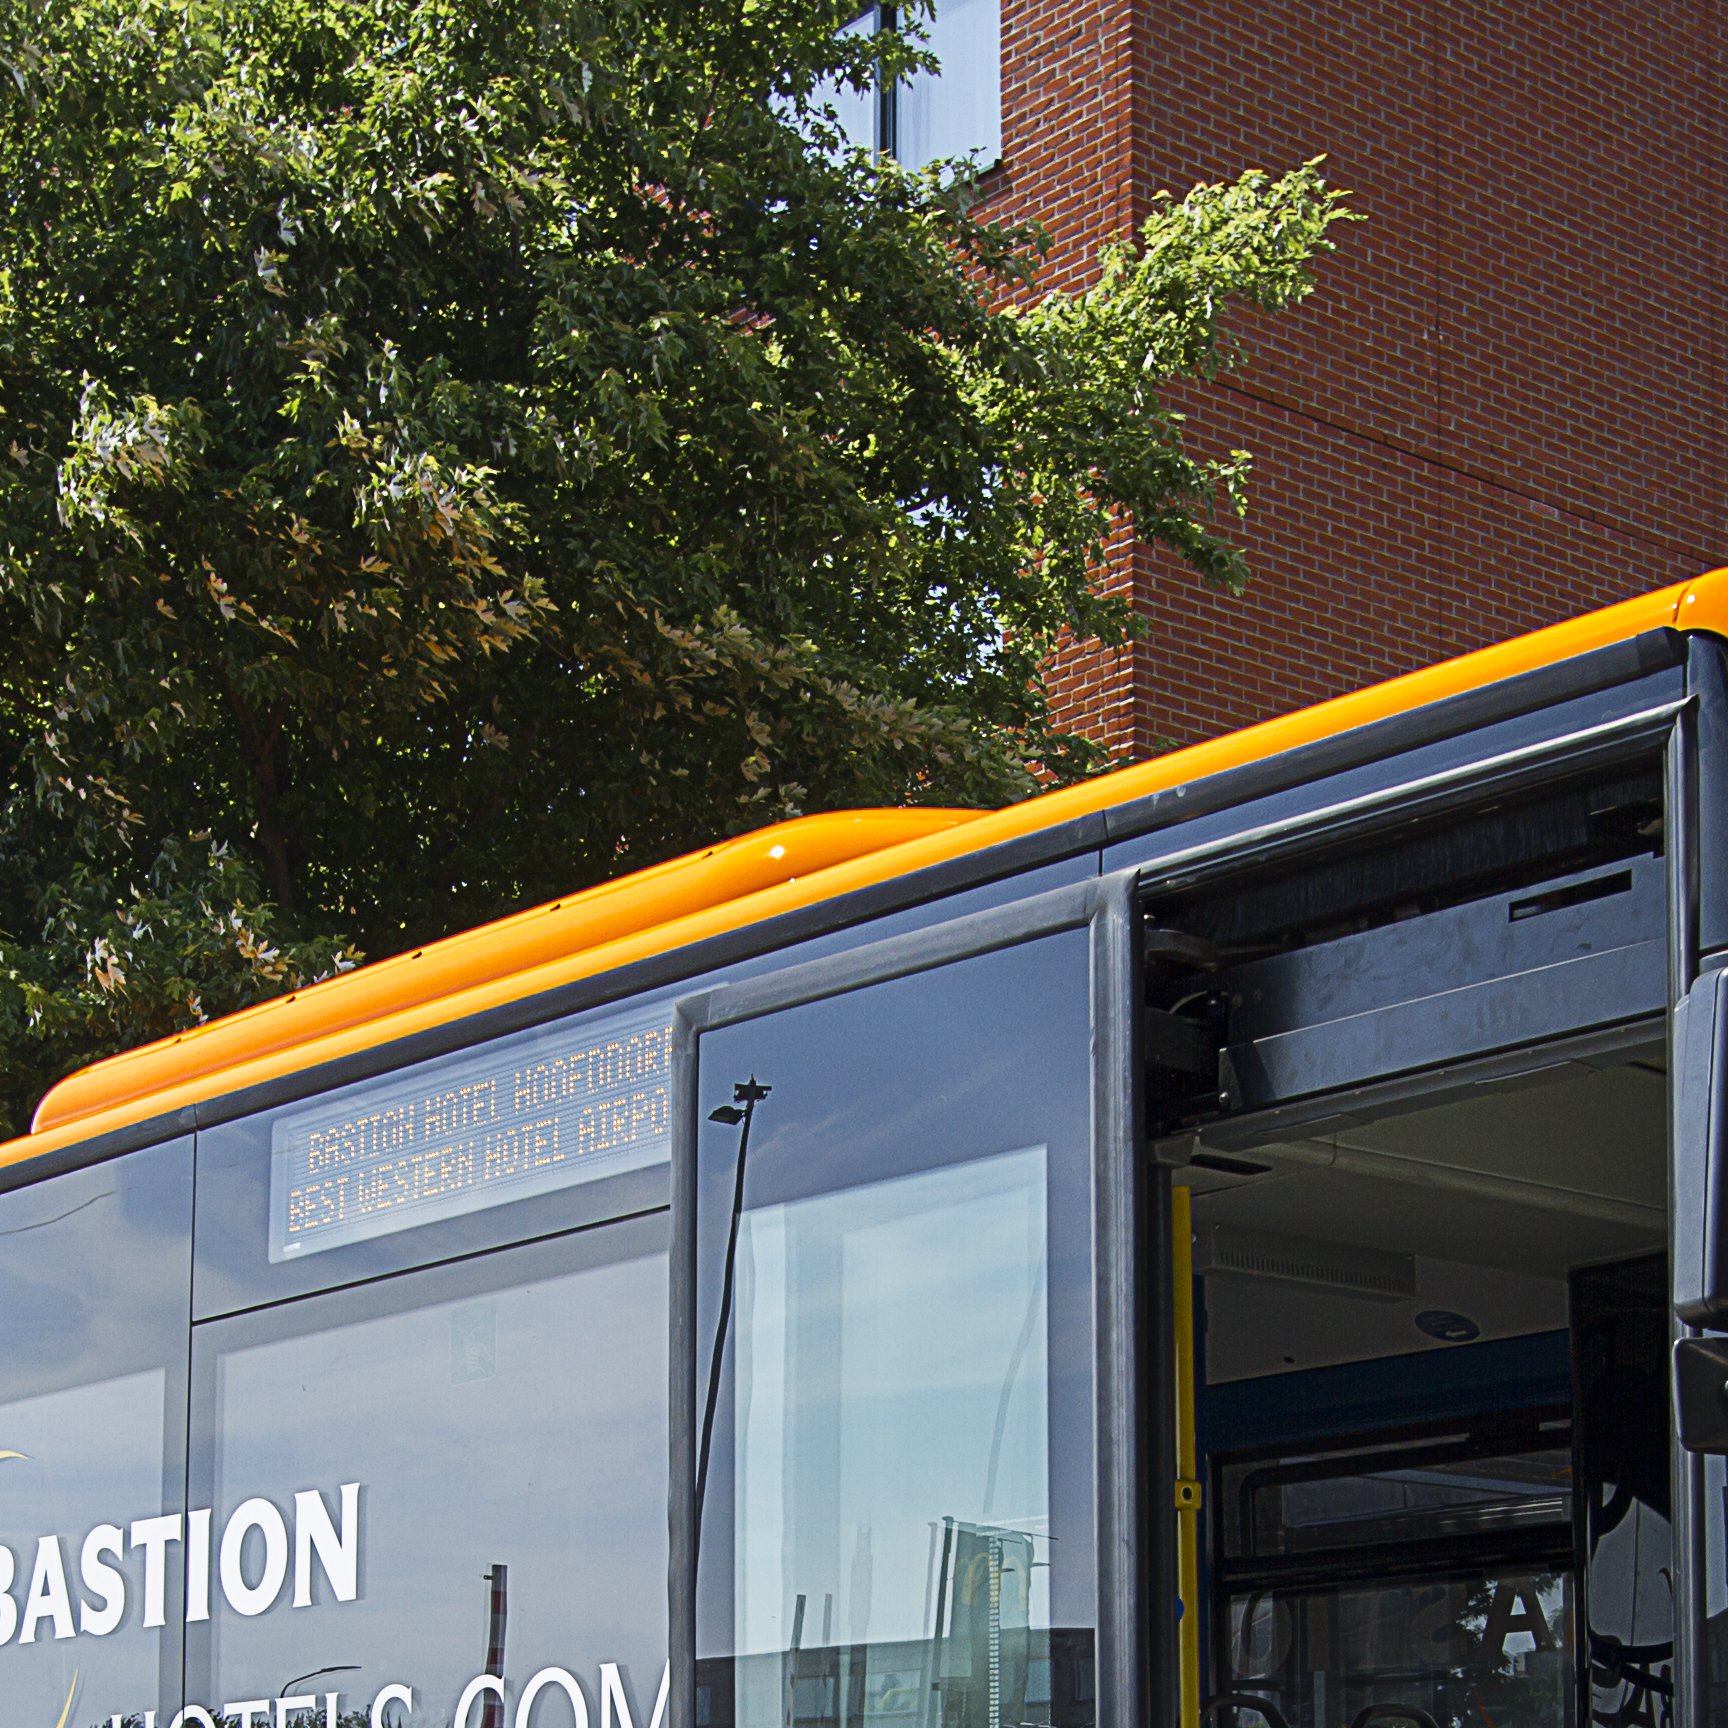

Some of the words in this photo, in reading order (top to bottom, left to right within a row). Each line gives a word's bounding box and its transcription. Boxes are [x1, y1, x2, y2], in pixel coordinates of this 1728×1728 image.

[288, 1177, 350, 1232] BEST
[358, 1140, 474, 1214] WESTERN
[484, 1117, 566, 1180] HOTEL
[578, 1087, 669, 1154] AIRPO
[309, 1103, 415, 1175] BASTION
[425, 1079, 501, 1141] HOTEL
